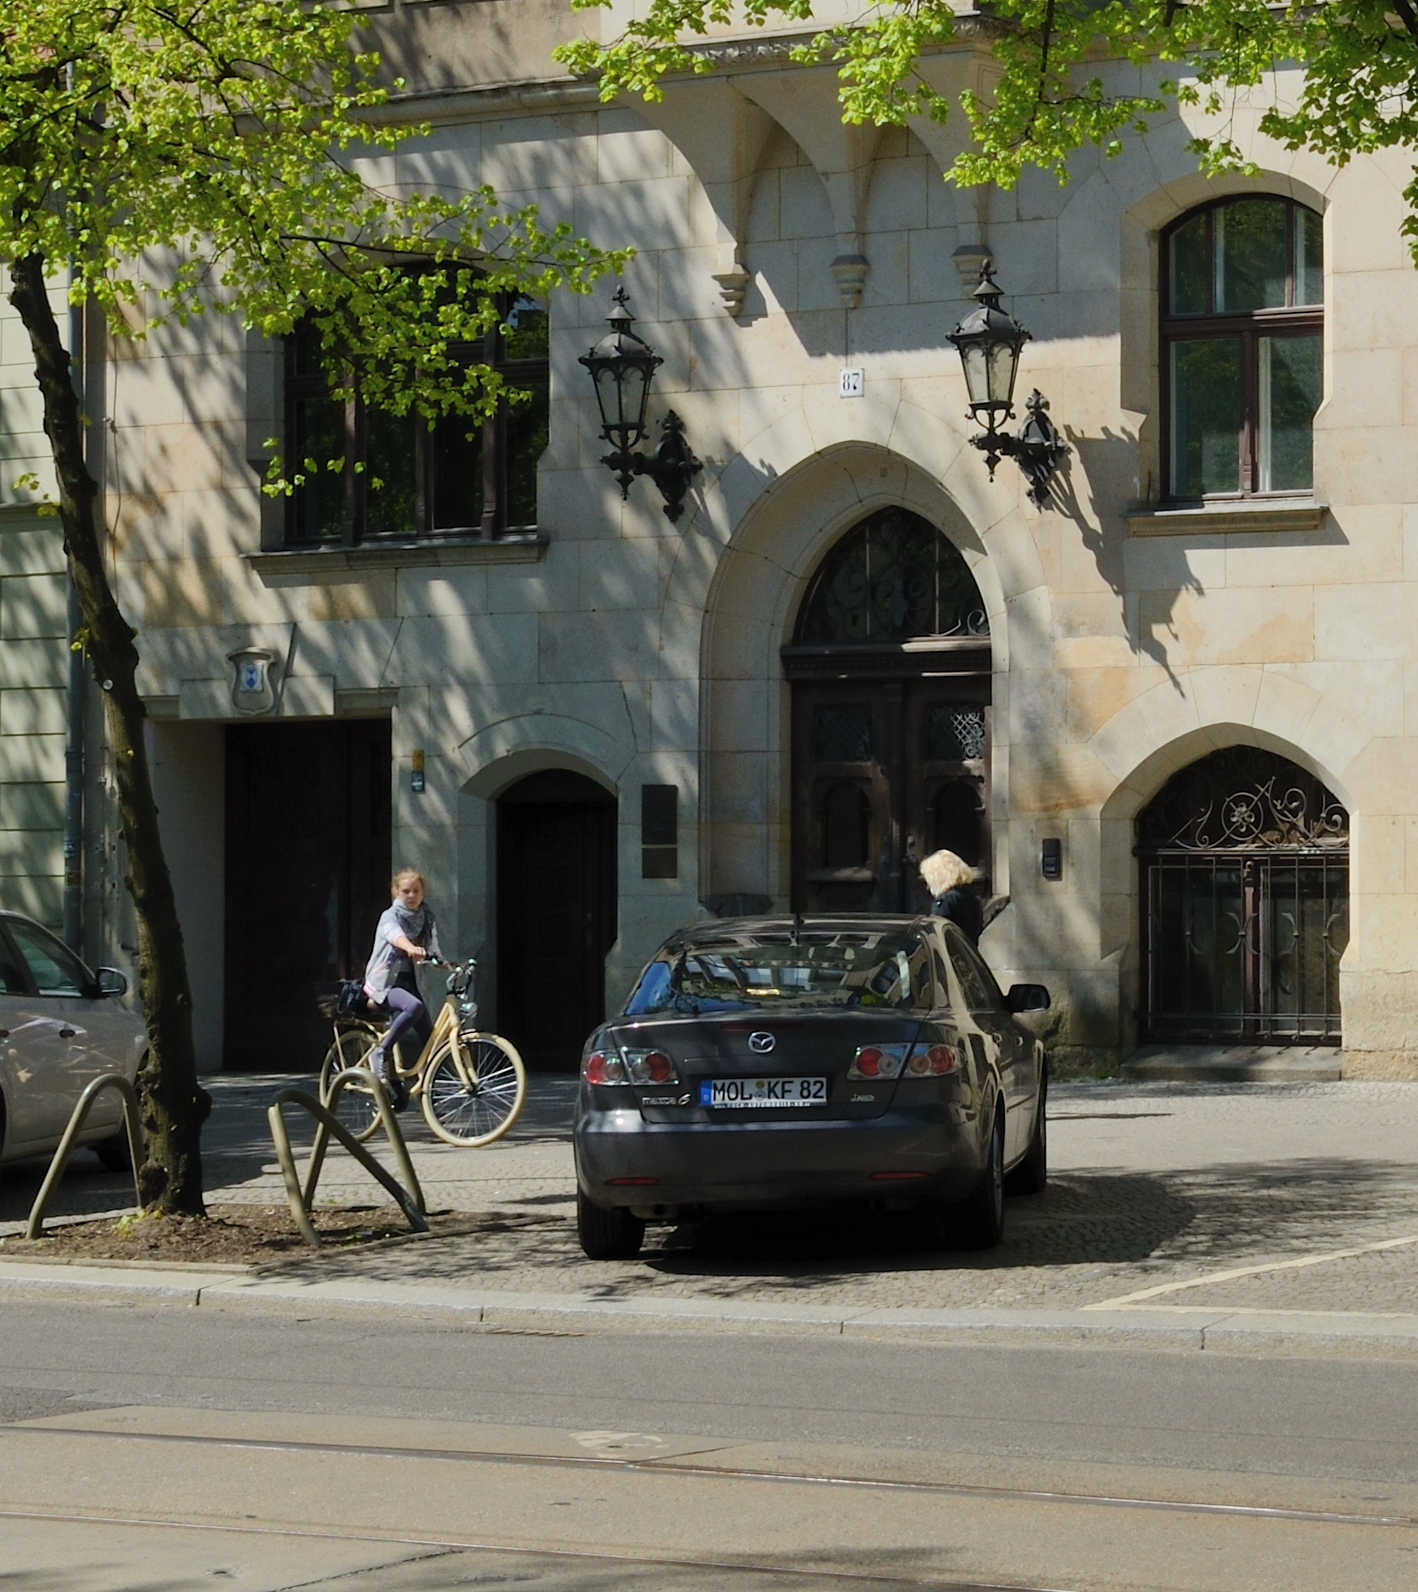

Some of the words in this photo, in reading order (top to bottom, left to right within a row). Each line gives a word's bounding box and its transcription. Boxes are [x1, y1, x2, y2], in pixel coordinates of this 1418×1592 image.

[842, 372, 860, 392] 87
[713, 1080, 752, 1102] MOL
[767, 1079, 794, 1100] KF
[799, 1079, 825, 1100] 82
